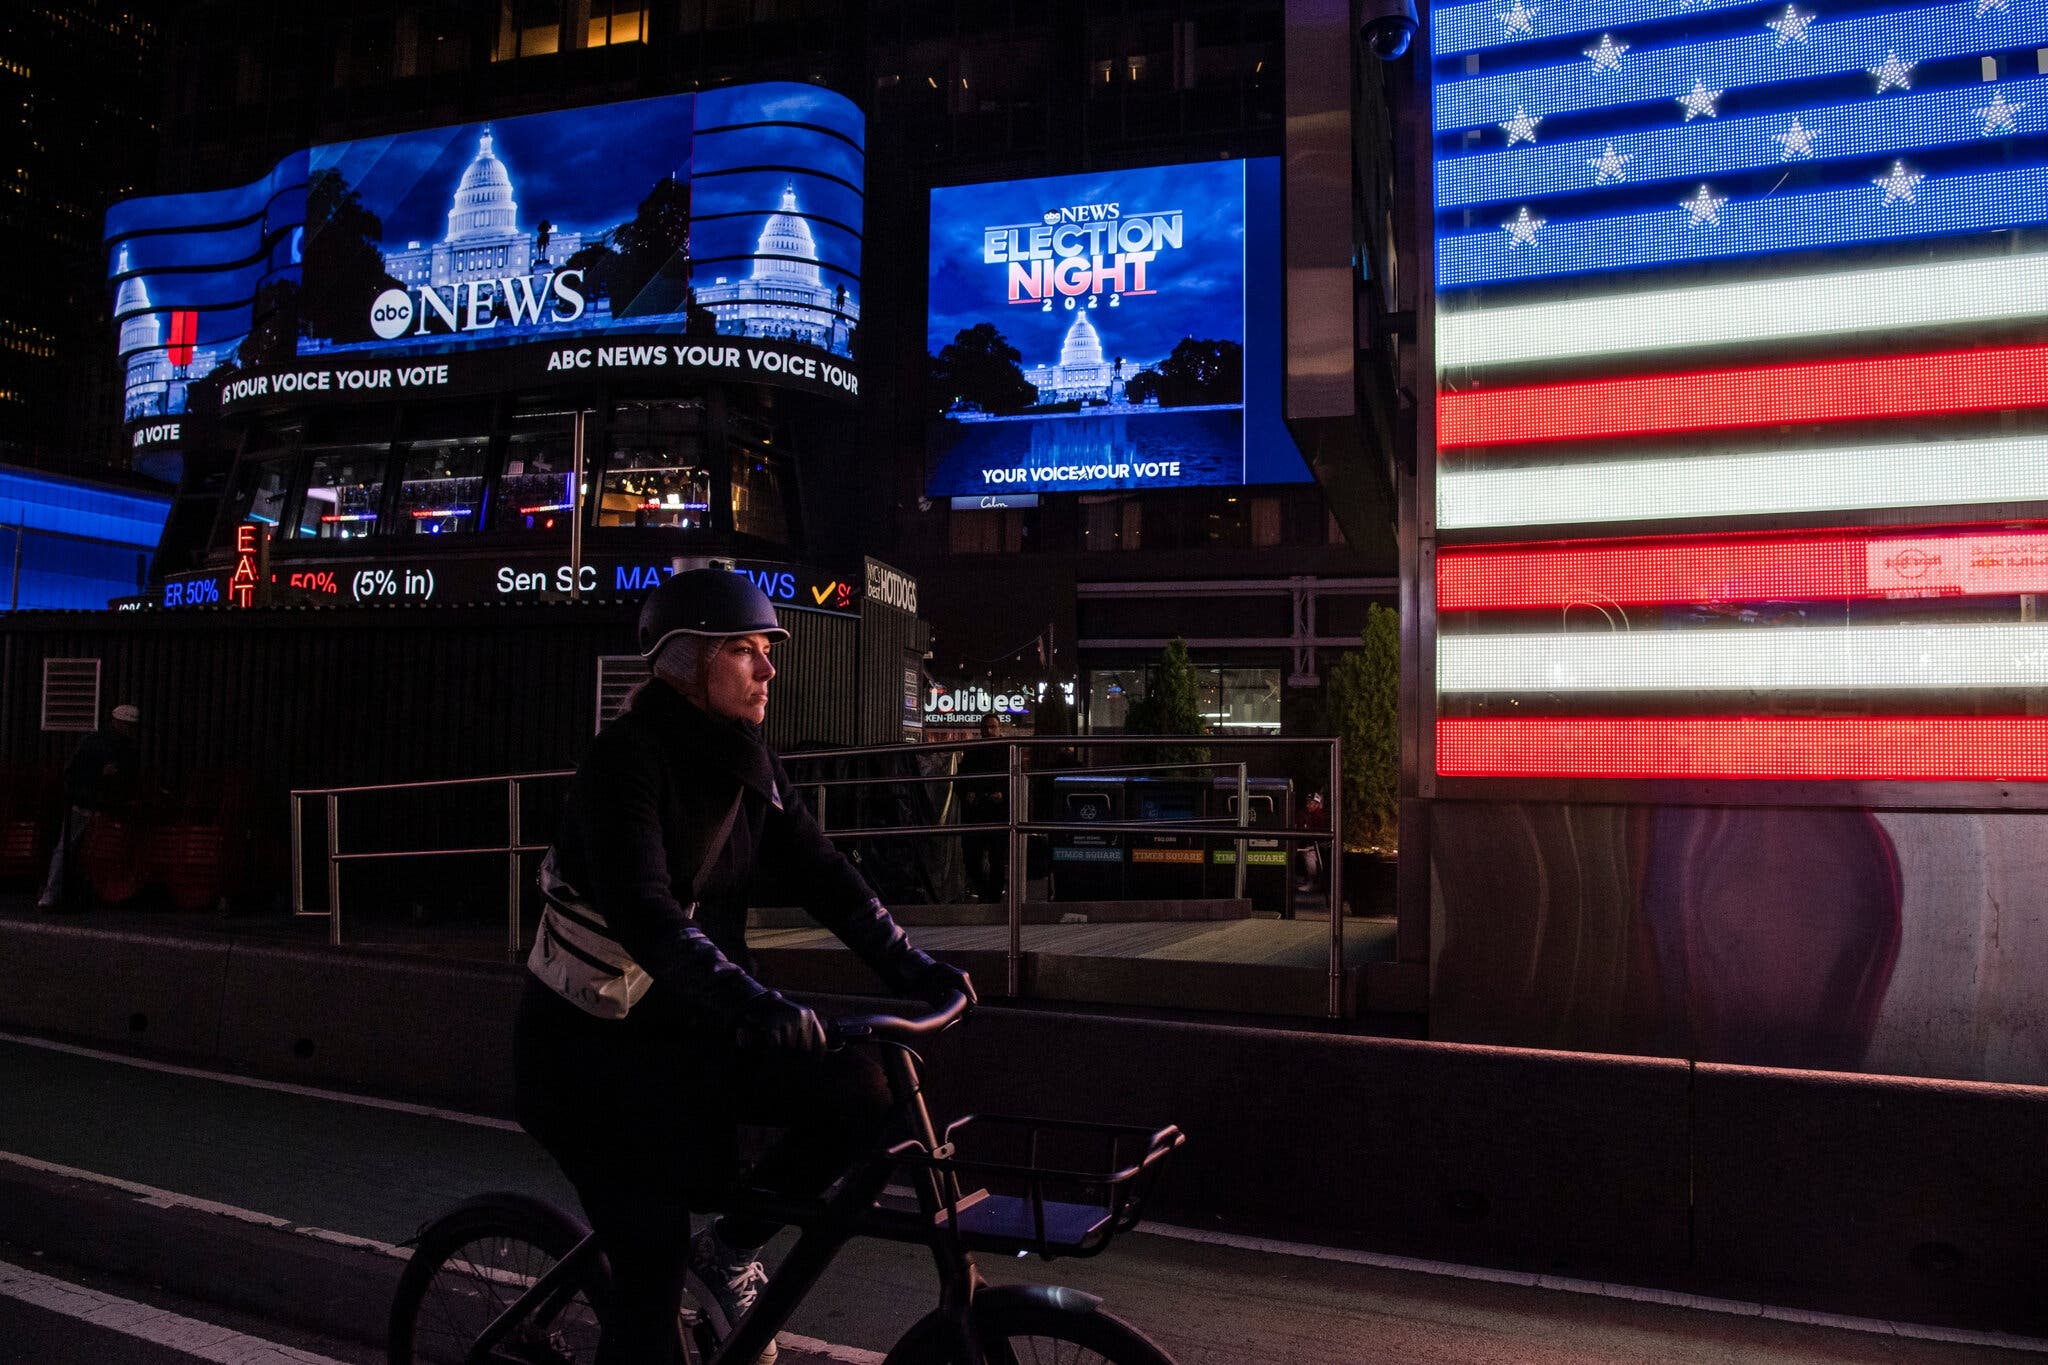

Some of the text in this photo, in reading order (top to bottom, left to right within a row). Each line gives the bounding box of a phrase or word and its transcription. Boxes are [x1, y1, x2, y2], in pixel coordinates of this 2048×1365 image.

[1061, 203, 1119, 223] NEWS
[984, 215, 1183, 264] ELECTION
[1009, 251, 1157, 300] NIGHT
[373, 269, 585, 336] abc NEWS
[232, 376, 267, 400] YOUR
[272, 371, 330, 393] VOICE
[335, 369, 392, 389] YOUR
[397, 365, 449, 387] VOTE
[547, 346, 858, 395] ABC NEWS YOUR VOICE YOUR
[132, 424, 180, 448] UR VOTE
[982, 461, 1181, 483] YOUR VOICE YOUR VOTE
[236, 524, 258, 608] EAT
[497, 567, 597, 592] Sen SC
[185, 578, 220, 604] 50%
[290, 572, 337, 593] 50%
[352, 570, 398, 602] (5%
[405, 568, 434, 601] in)
[881, 567, 917, 613] HOTDOGS
[924, 686, 1026, 713] Jollibee
[1135, 852, 1202, 861] TIMES SQUARE
[1247, 854, 1285, 863] SQUARE
